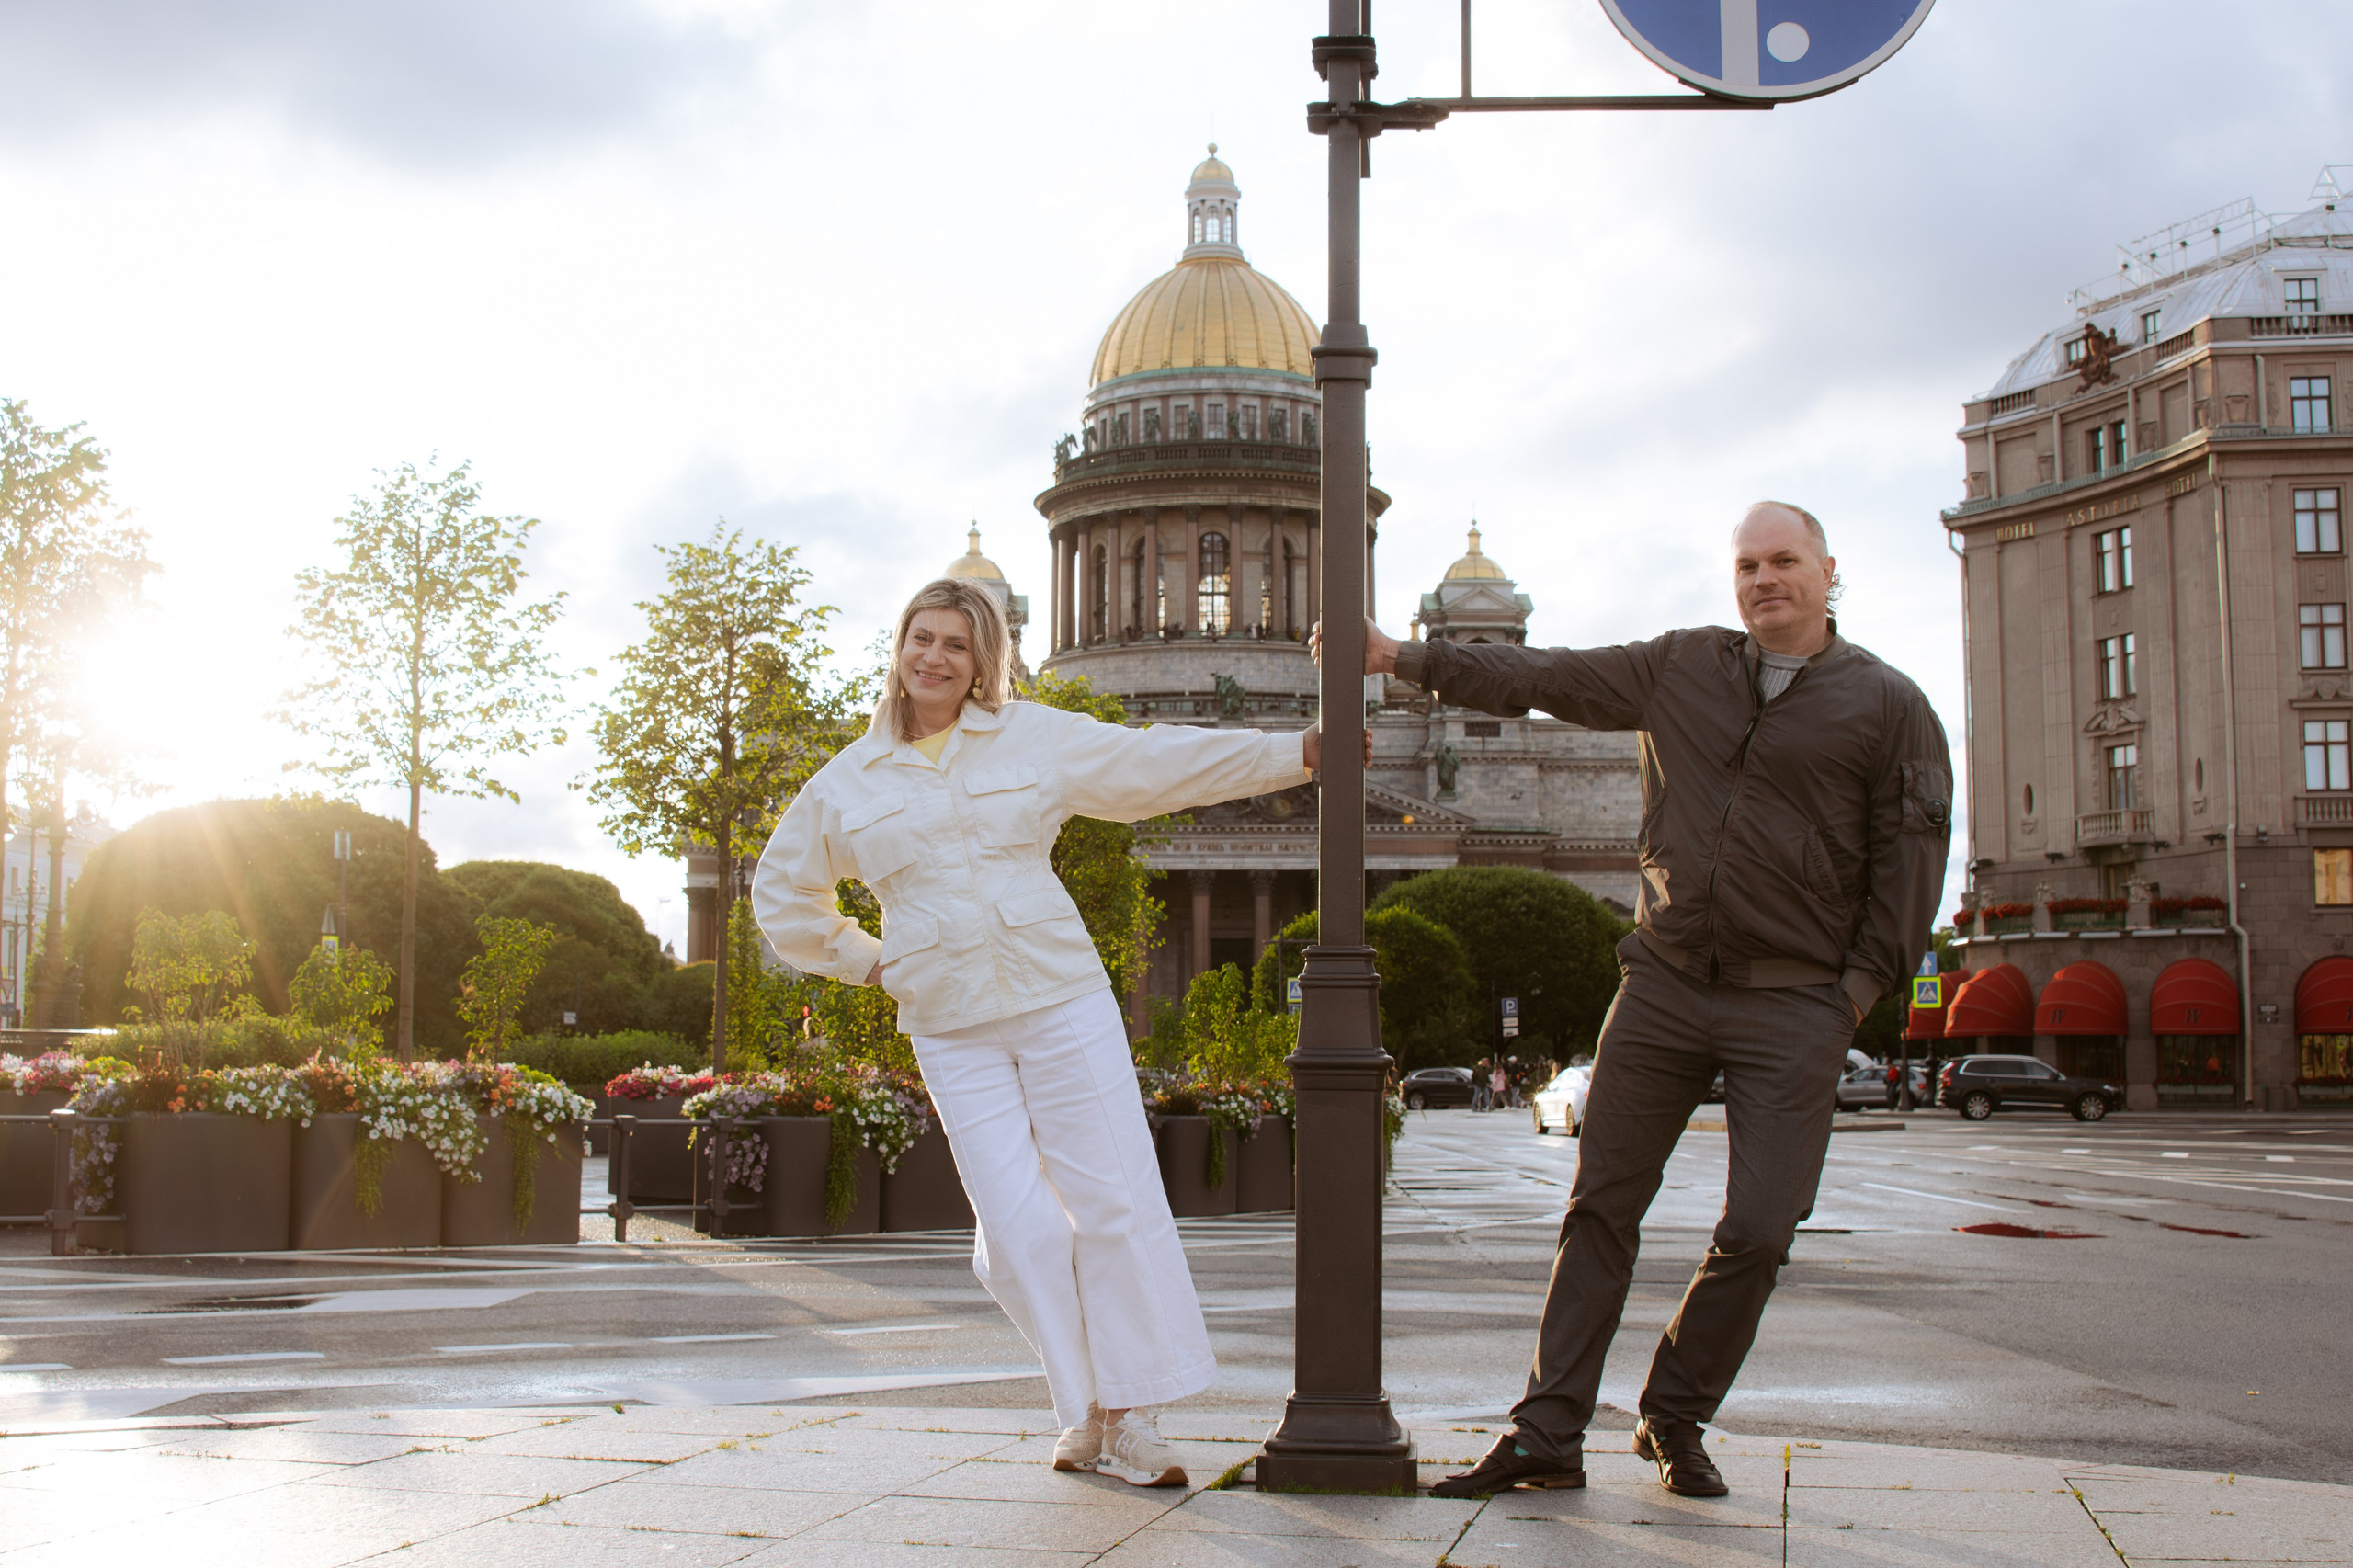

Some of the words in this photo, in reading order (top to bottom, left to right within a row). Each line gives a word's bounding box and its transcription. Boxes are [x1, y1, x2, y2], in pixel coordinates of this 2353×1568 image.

[1996, 521, 2034, 542] HOTEL
[2066, 494, 2141, 527] ASTORIA
[2165, 472, 2196, 497] HOTEL
